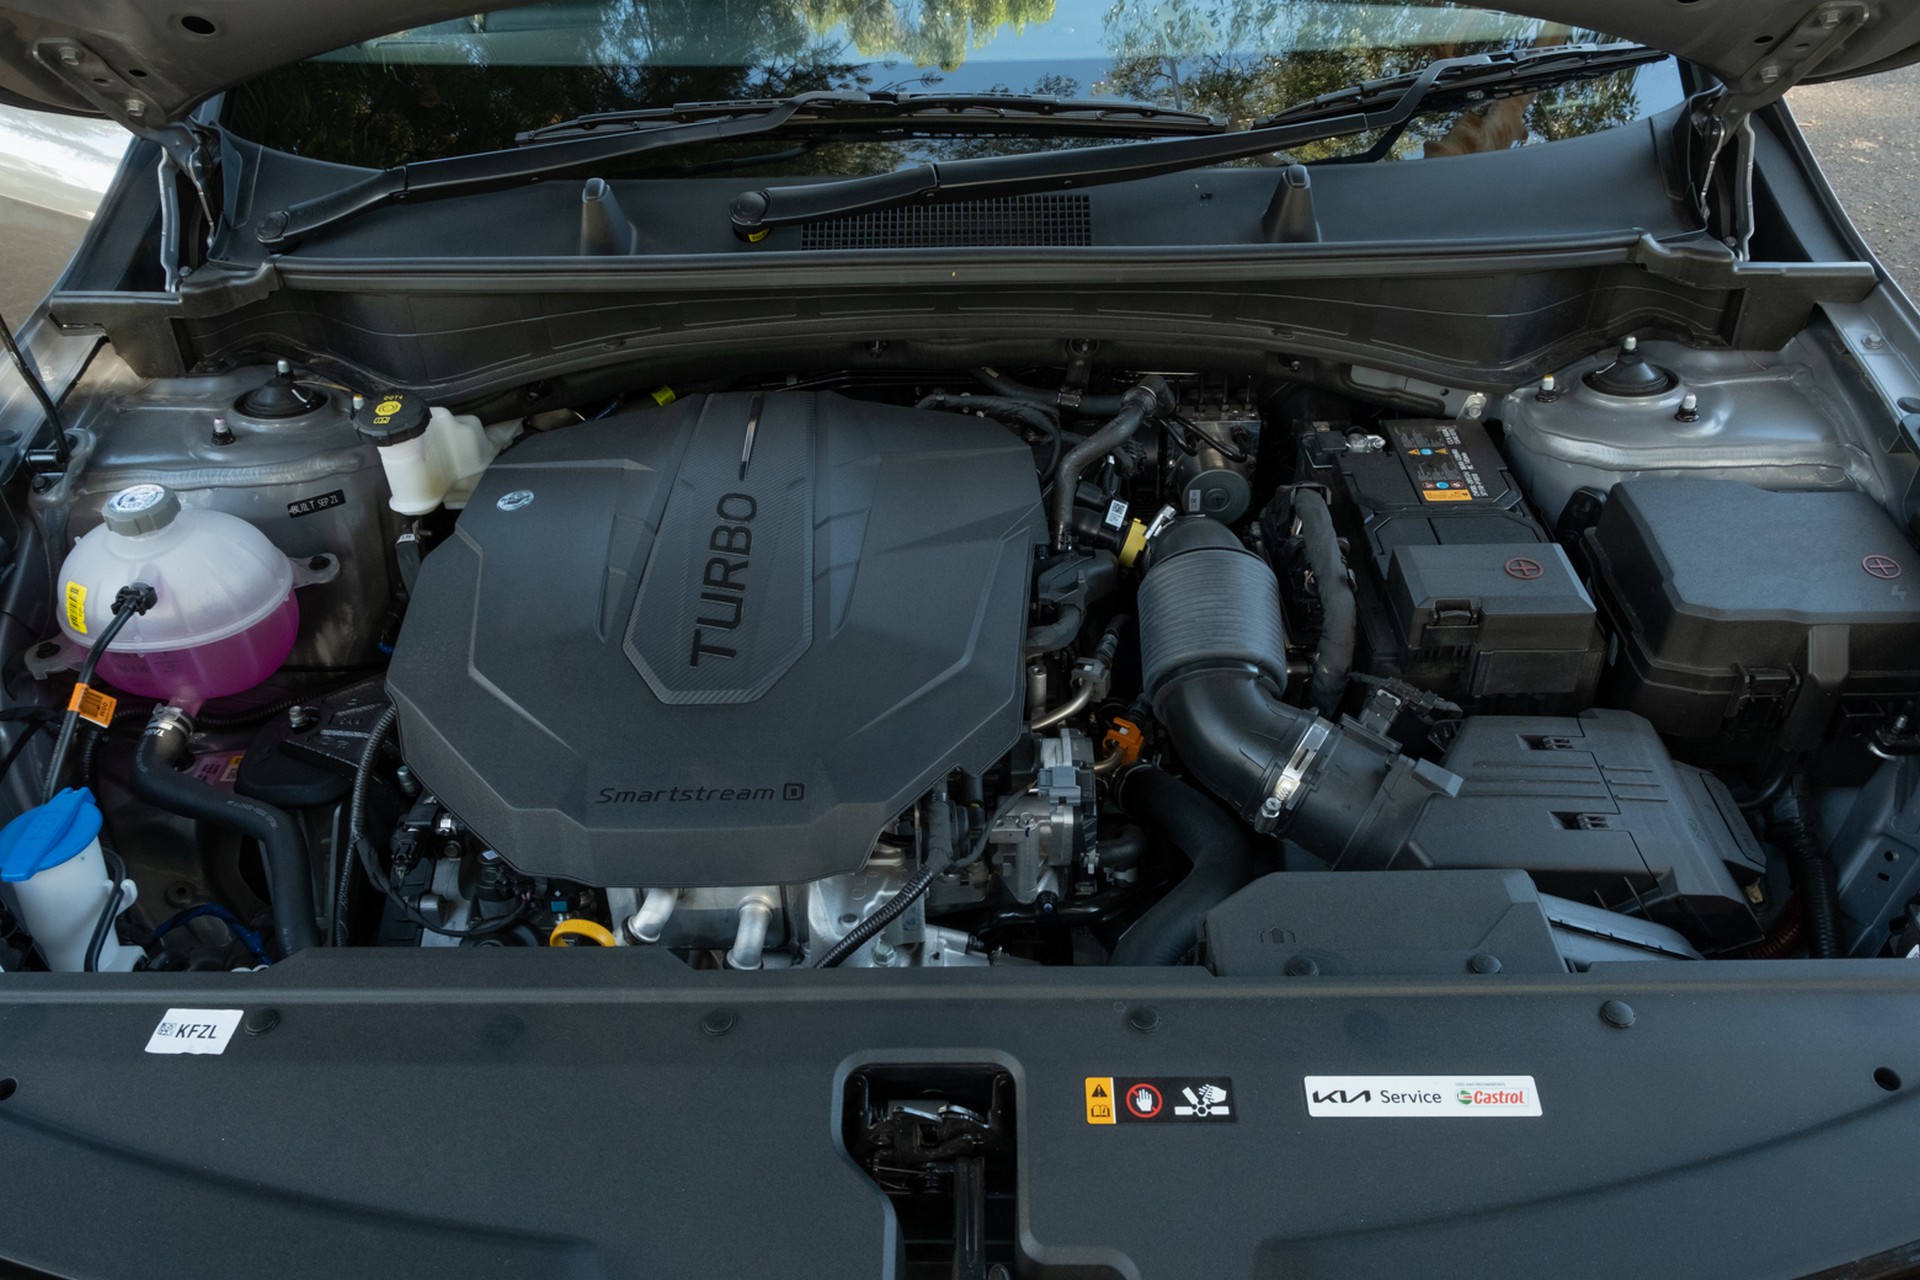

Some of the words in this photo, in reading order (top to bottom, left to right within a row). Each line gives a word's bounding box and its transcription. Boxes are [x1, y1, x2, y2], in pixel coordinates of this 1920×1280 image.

[316, 497, 330, 507] SEP
[330, 494, 338, 504] 21
[689, 492, 757, 668] TURBO
[597, 785, 776, 804] Smartstream
[175, 1024, 217, 1039] KFZL
[1312, 1090, 1372, 1104] KIA
[1380, 1090, 1442, 1104] Service
[1473, 1090, 1525, 1105] Castrol
